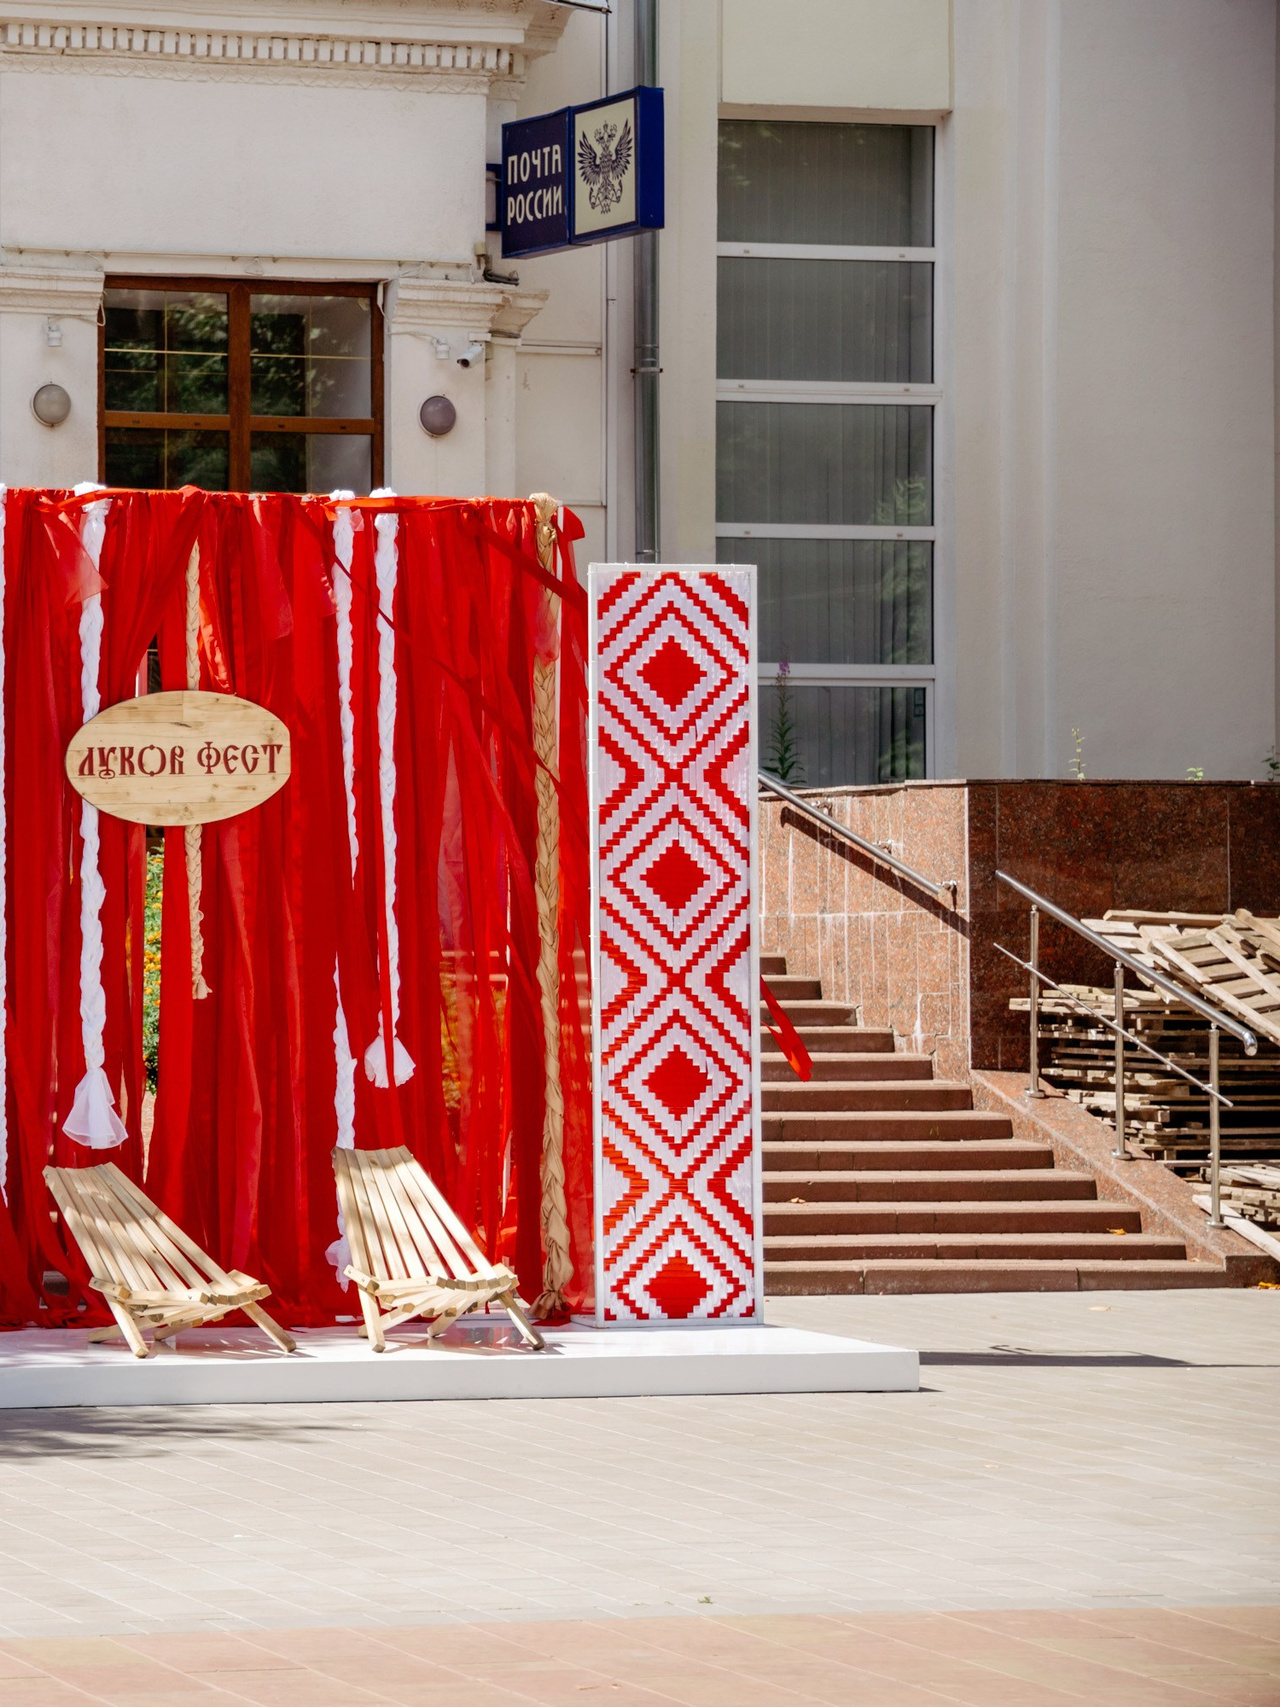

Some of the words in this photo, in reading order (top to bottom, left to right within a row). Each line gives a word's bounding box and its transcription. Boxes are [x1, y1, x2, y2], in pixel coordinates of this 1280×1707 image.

[507, 144, 562, 185] ПОЧТА
[507, 184, 563, 226] РОССИИ
[197, 741, 283, 775] ФЕСТ
